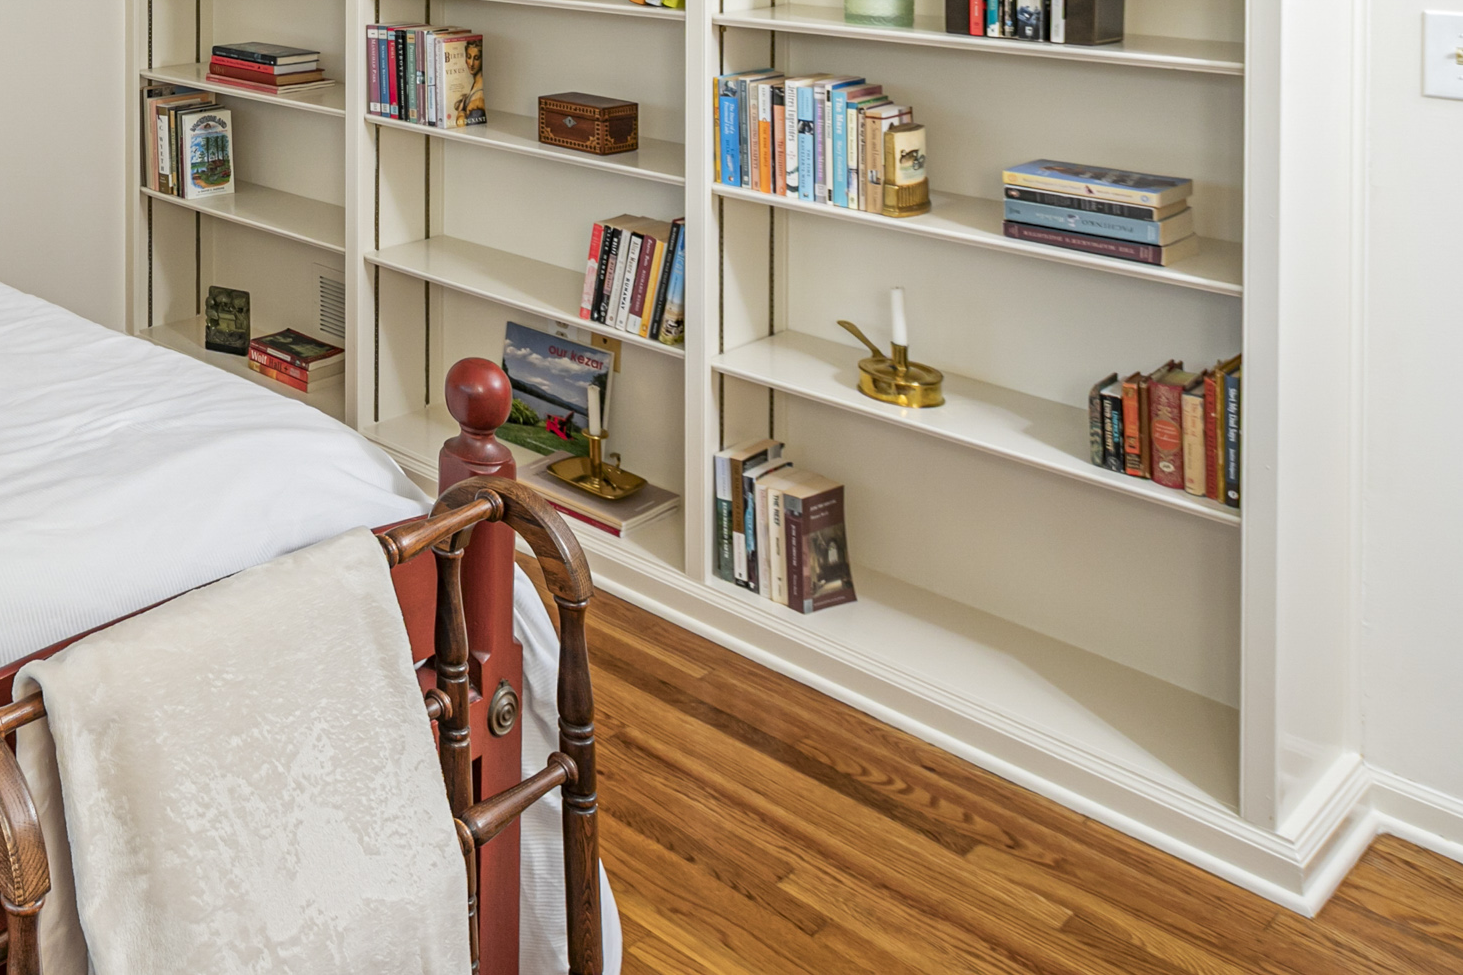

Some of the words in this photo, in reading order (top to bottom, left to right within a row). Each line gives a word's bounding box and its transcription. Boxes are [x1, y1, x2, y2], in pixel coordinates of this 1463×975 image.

[444, 52, 464, 63] BIRTH
[787, 85, 796, 108] Jeffrey
[786, 110, 796, 142] Eugenides
[1081, 219, 1134, 233] PACHINKO
[627, 257, 635, 274] Munro
[638, 270, 646, 293] RICHARD
[620, 277, 630, 310] RUNAWAY
[251, 350, 267, 364] Wolf
[269, 358, 282, 370] Hall
[548, 344, 567, 357] our
[570, 350, 604, 370] kezar
[1227, 429, 1237, 442] Says
